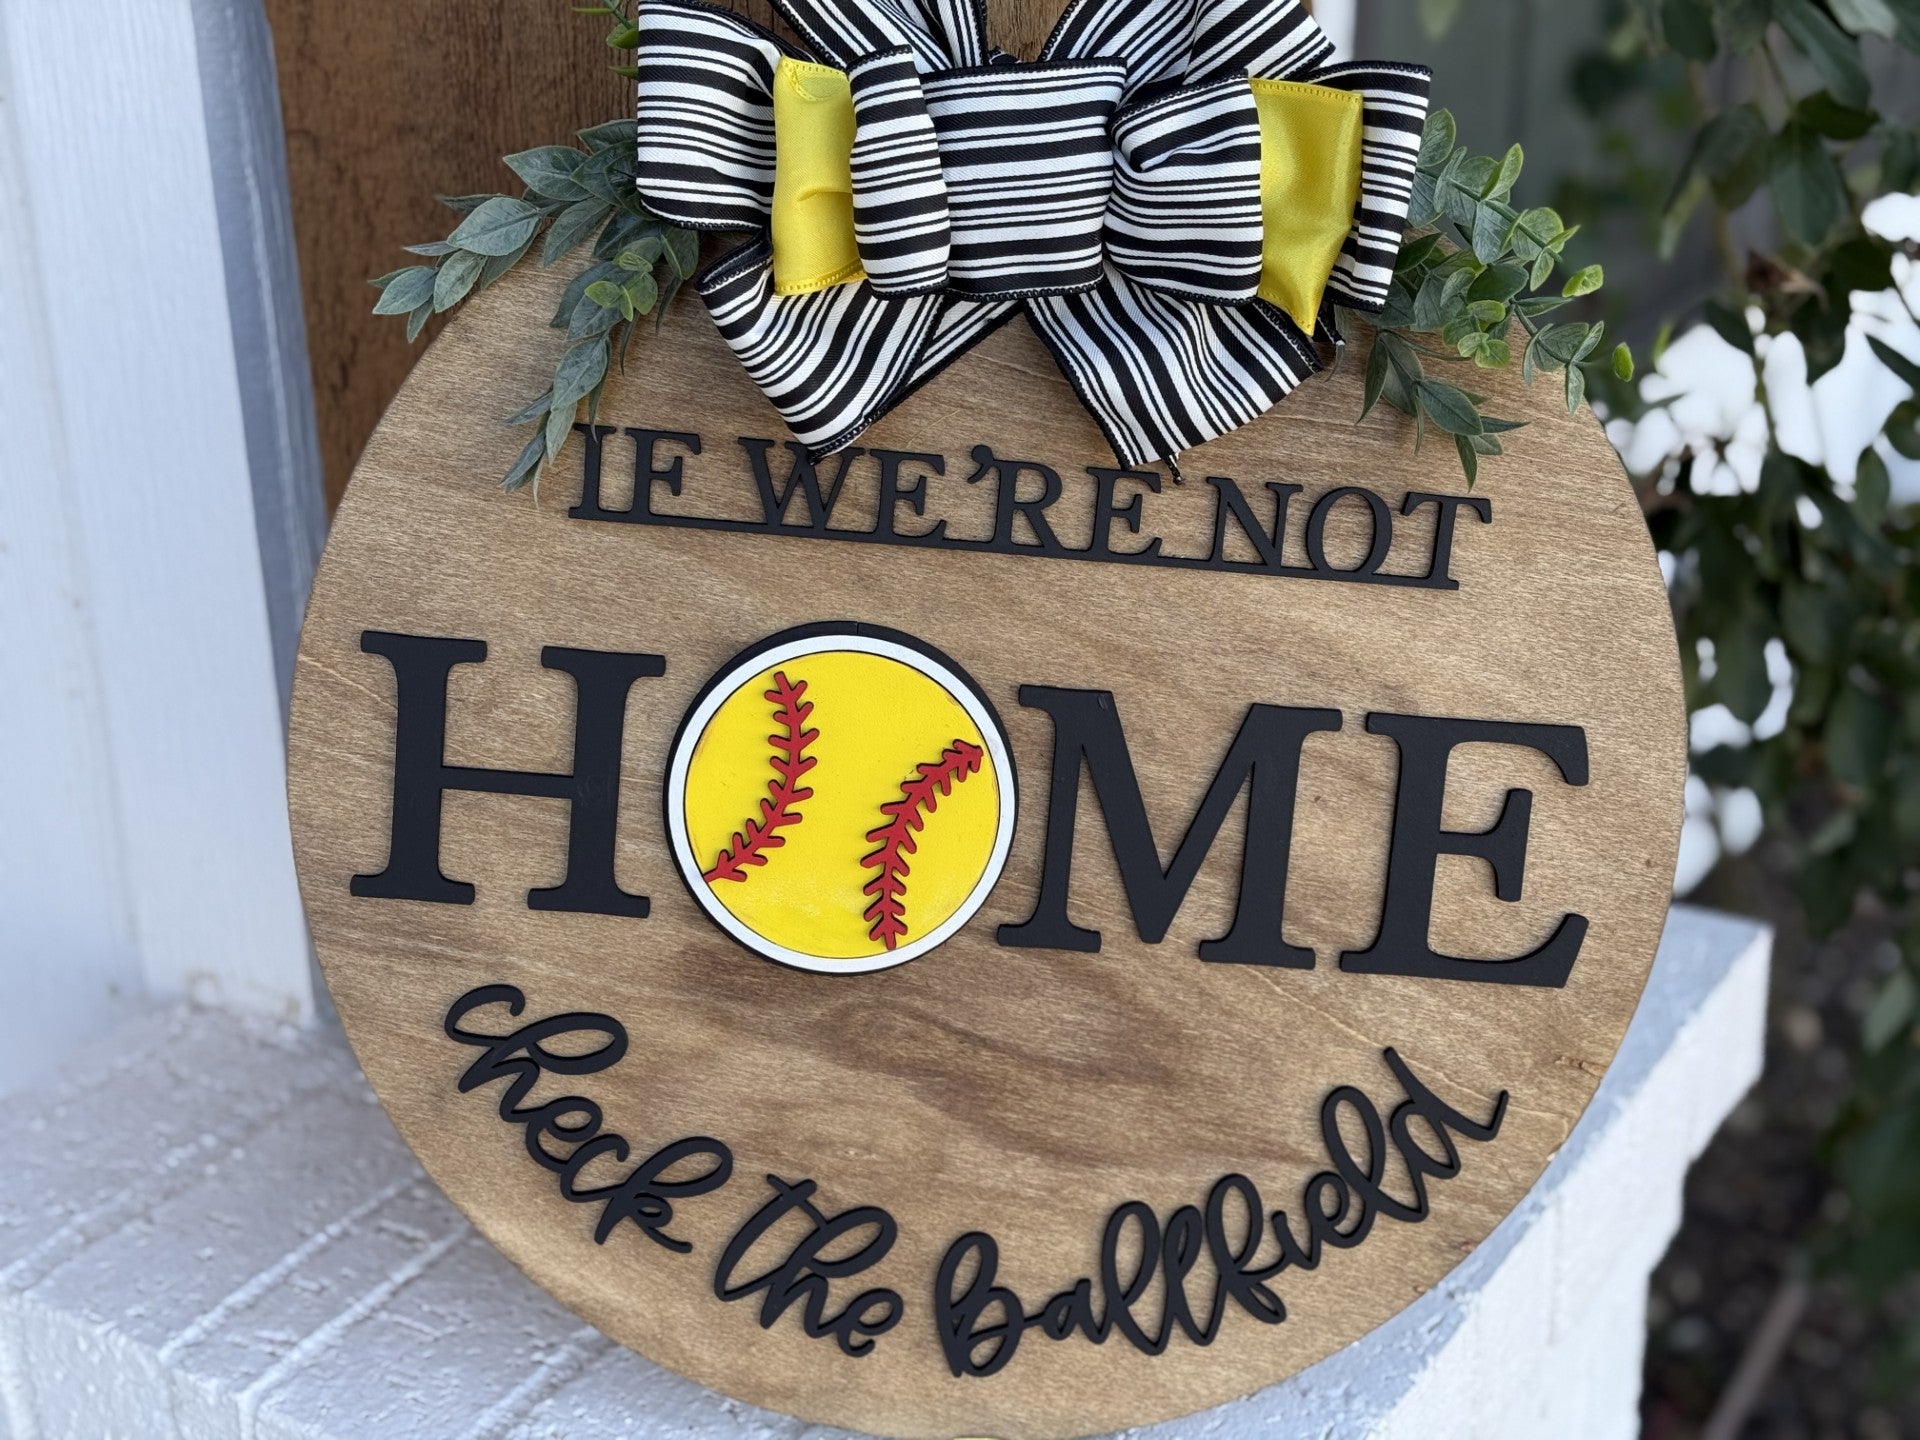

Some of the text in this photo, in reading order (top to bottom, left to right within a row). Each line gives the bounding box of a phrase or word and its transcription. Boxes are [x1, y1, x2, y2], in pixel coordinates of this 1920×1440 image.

[568, 423, 1494, 591] IF WE'RE NOT
[444, 984, 734, 1254] check
[714, 1173, 904, 1358] the
